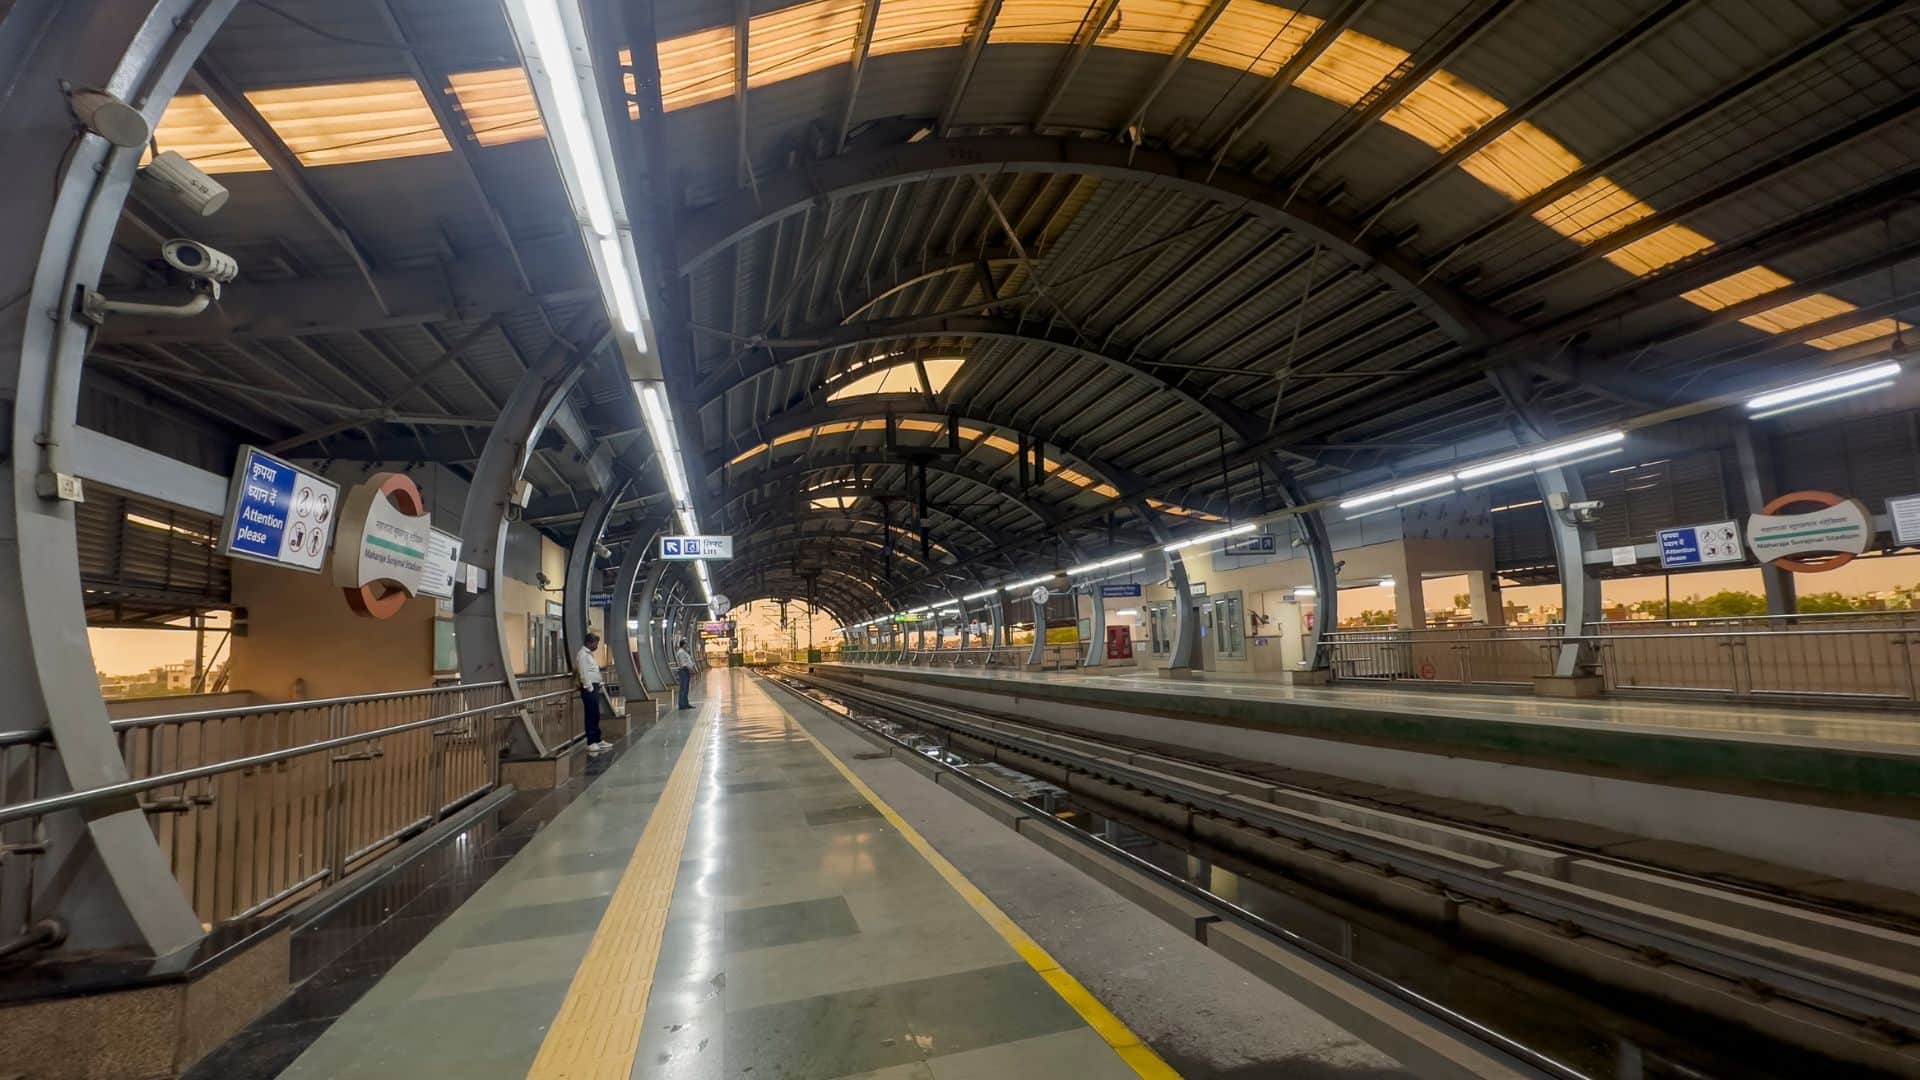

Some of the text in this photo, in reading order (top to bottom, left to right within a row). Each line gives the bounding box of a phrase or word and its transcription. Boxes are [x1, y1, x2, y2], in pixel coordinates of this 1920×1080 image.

[252, 462, 277, 482] कृपया
[247, 485, 269, 503] ध्यान
[242, 506, 283, 530] Attention
[237, 526, 267, 544] please
